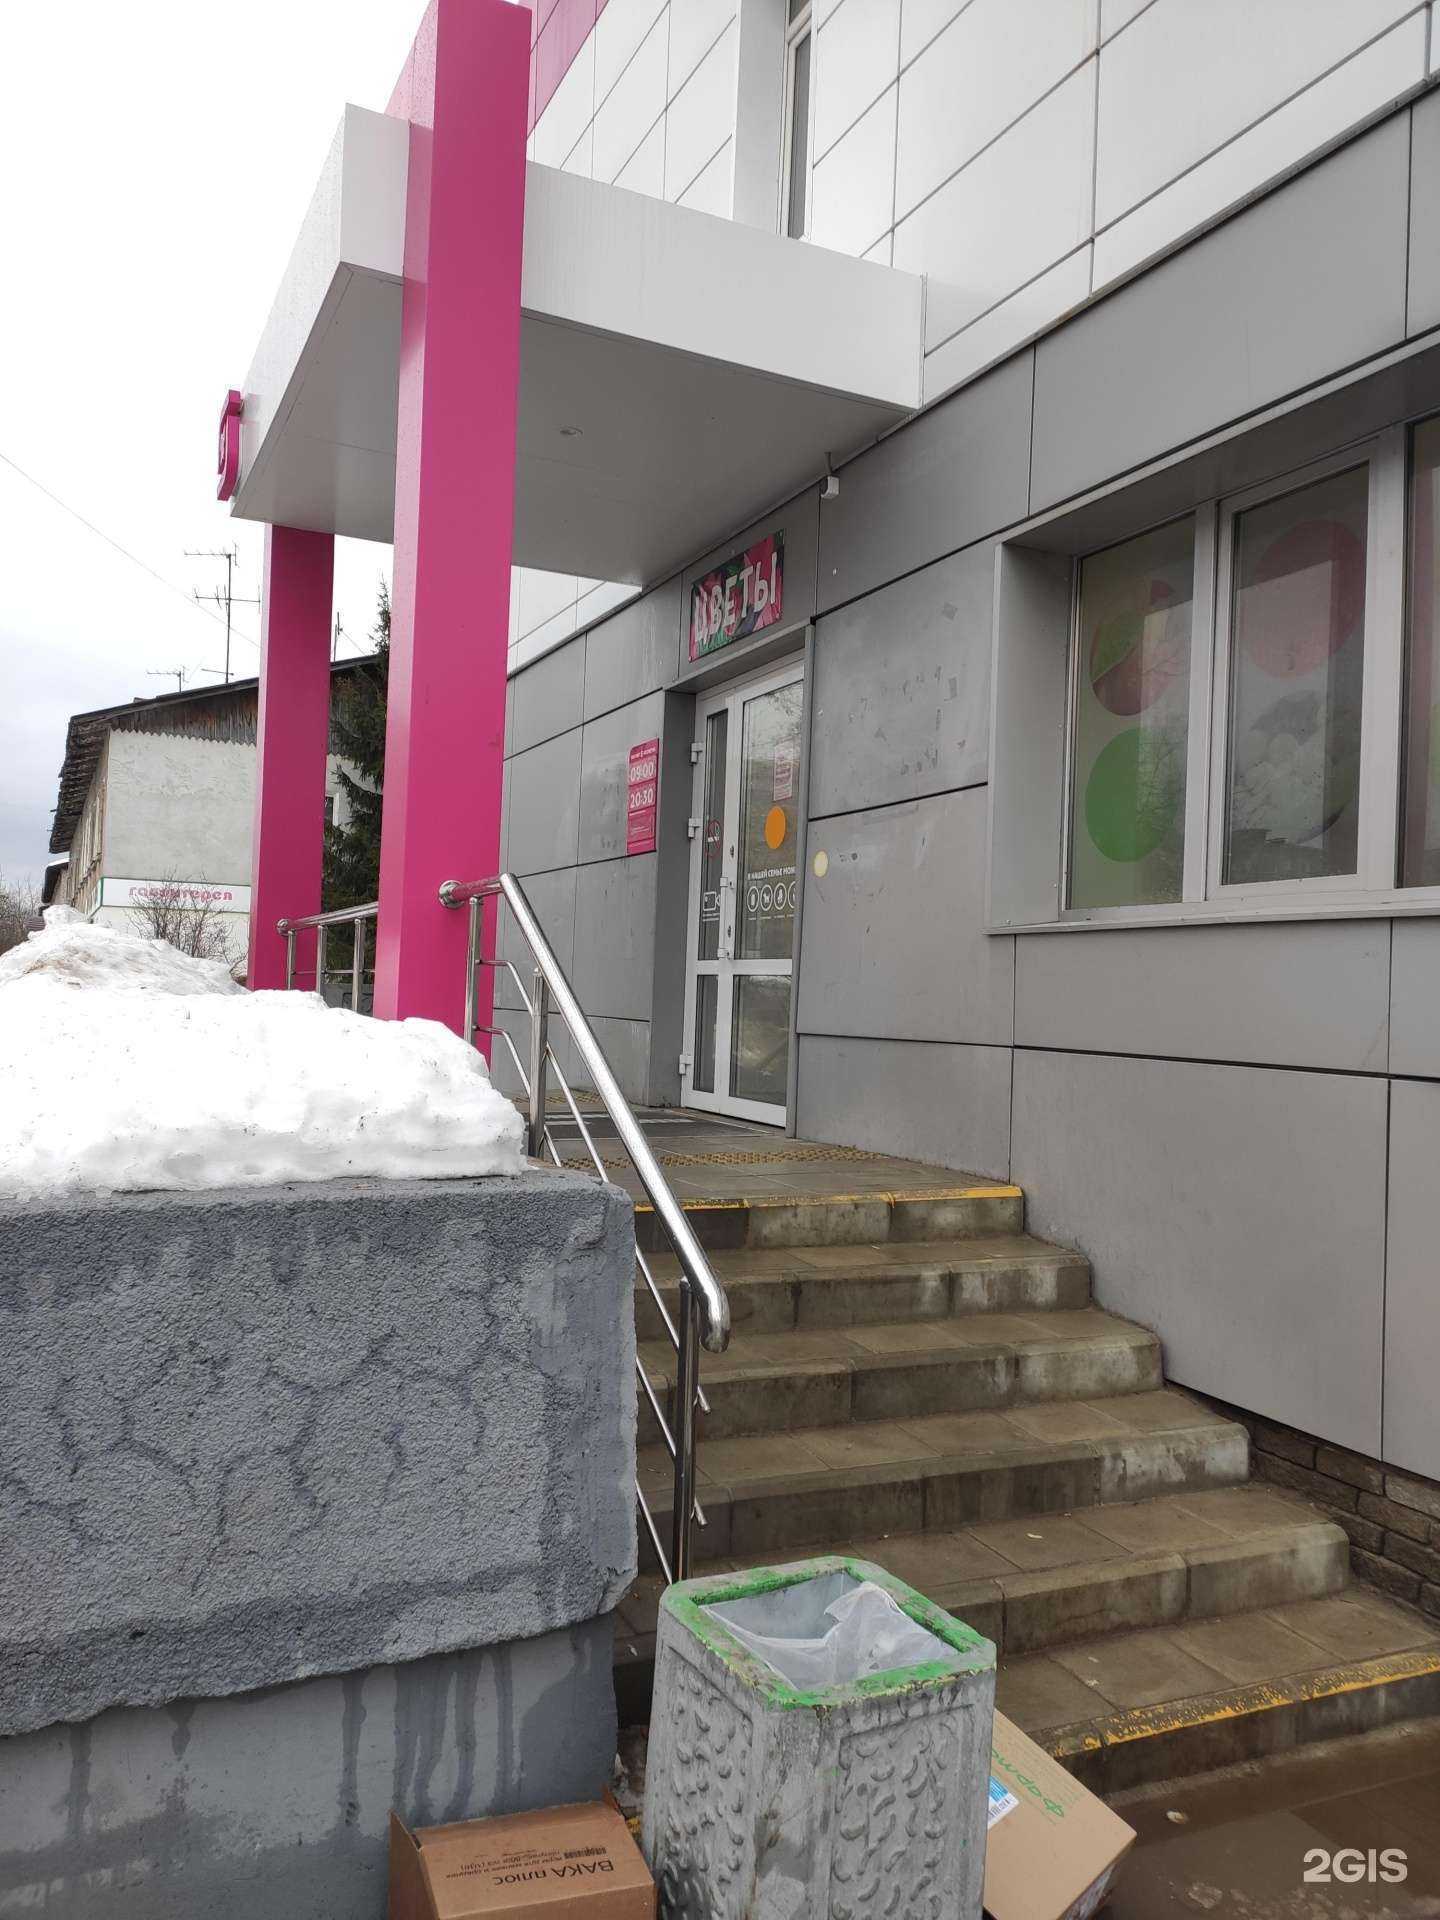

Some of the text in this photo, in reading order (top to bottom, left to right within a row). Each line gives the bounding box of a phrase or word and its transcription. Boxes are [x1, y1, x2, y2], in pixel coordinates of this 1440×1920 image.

[695, 552, 777, 645] ЦВЕТЫ
[630, 788, 654, 809] 20:30
[495, 1869, 547, 1885] плюс
[552, 1859, 614, 1878] ВАКА
